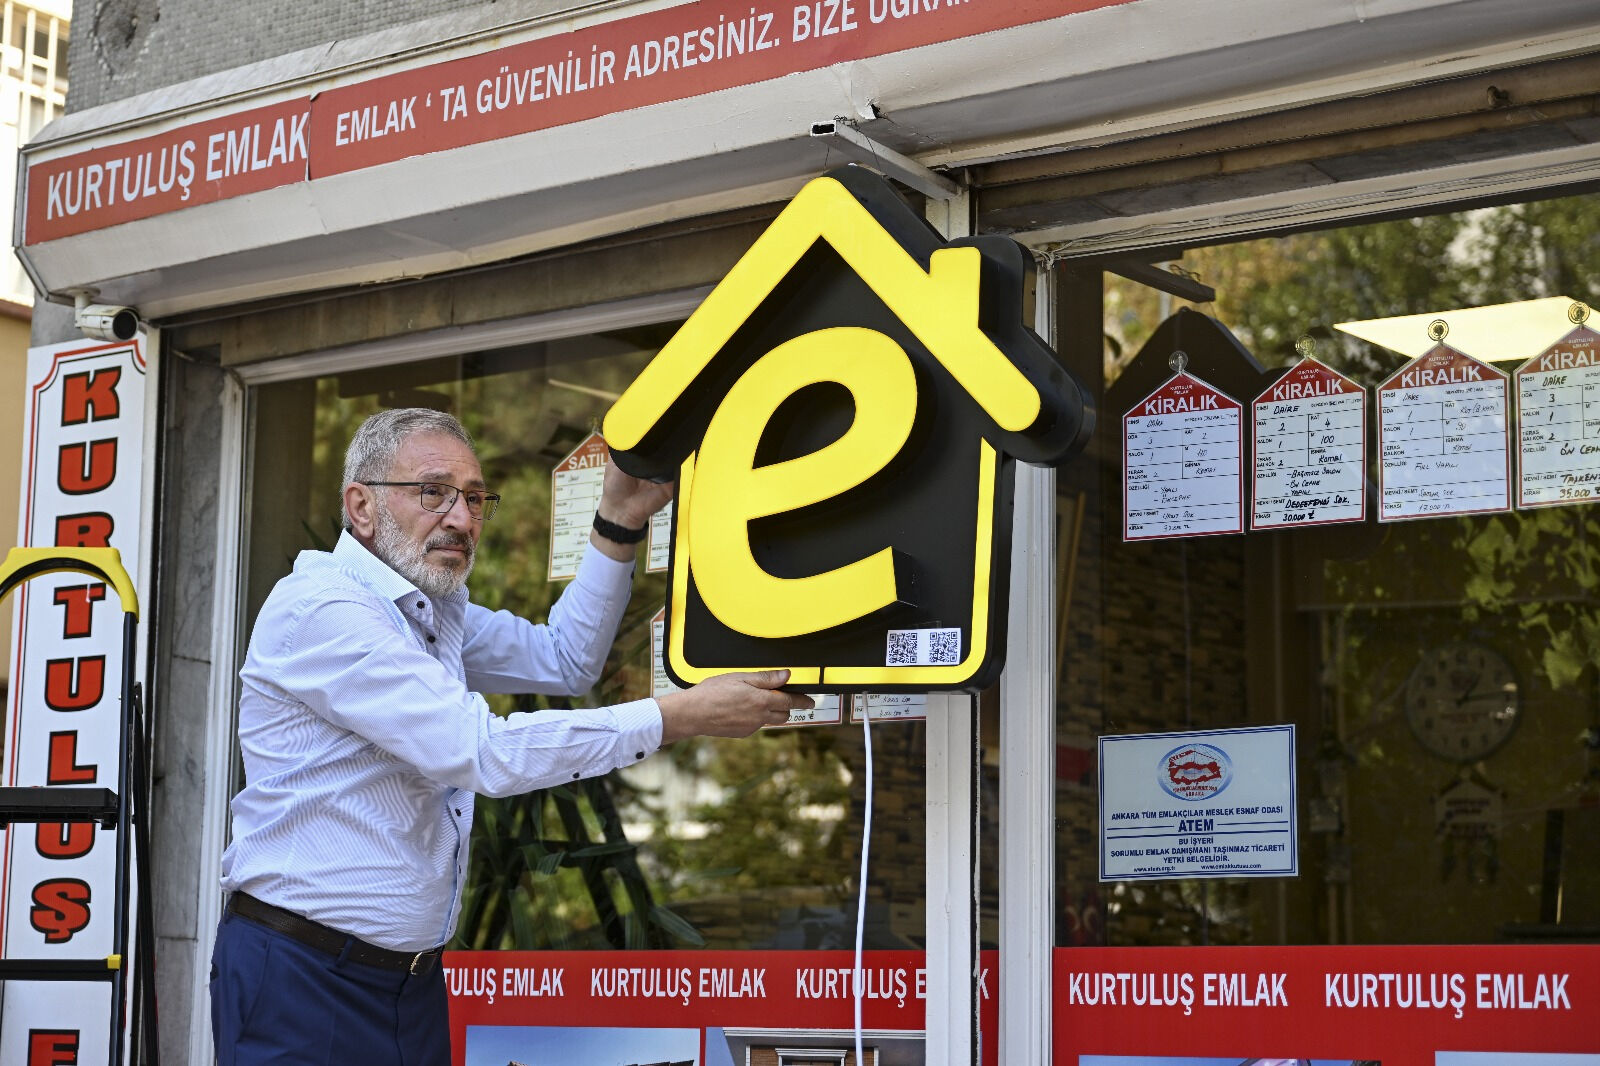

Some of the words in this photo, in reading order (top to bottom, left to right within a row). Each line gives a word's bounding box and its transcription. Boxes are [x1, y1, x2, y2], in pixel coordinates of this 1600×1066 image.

[336, 96, 416, 147] EMLAK
[440, 84, 468, 122] TA
[476, 44, 617, 115] GÜVENİLİR
[623, 11, 781, 82] ADRESİNİZ.
[46, 139, 197, 221] KURTULUŞ
[206, 112, 309, 182] EMLAK
[1401, 365, 1483, 388] KİRALIK
[1273, 379, 1344, 401] KİRALIK
[1145, 394, 1219, 416] KİRALIK
[30, 365, 122, 945] KURTULUŞ
[1111, 812, 1140, 820] ANKARA
[1142, 810, 1157, 819] TÜM
[1158, 809, 1204, 819] EMLAKÇILAR
[1205, 808, 1235, 816] MESLEK
[1236, 807, 1260, 815] ESNAF
[1178, 818, 1214, 832] ATEM
[1110, 849, 1144, 857] SORUMLU
[1145, 848, 1170, 856] EMLAK
[1171, 846, 1211, 855] DANIŞMANI
[1212, 845, 1250, 854] TAŞINMAZ
[1250, 843, 1285, 852] TİCARETİ
[1190, 836, 1214, 846] İŞYERİ
[1163, 854, 1184, 864] YETKİ
[1186, 853, 1230, 863] BELGELİDİR.
[502, 966, 565, 997] EMLAK
[590, 967, 692, 1006] KURTULUŞ
[698, 967, 767, 999] EMLAK
[1068, 972, 1195, 1016] KURTULUŞ
[1203, 972, 1289, 1008] EMLAK
[1324, 972, 1467, 1019] KURTULUŞ
[1475, 972, 1572, 1010] EMLAK
